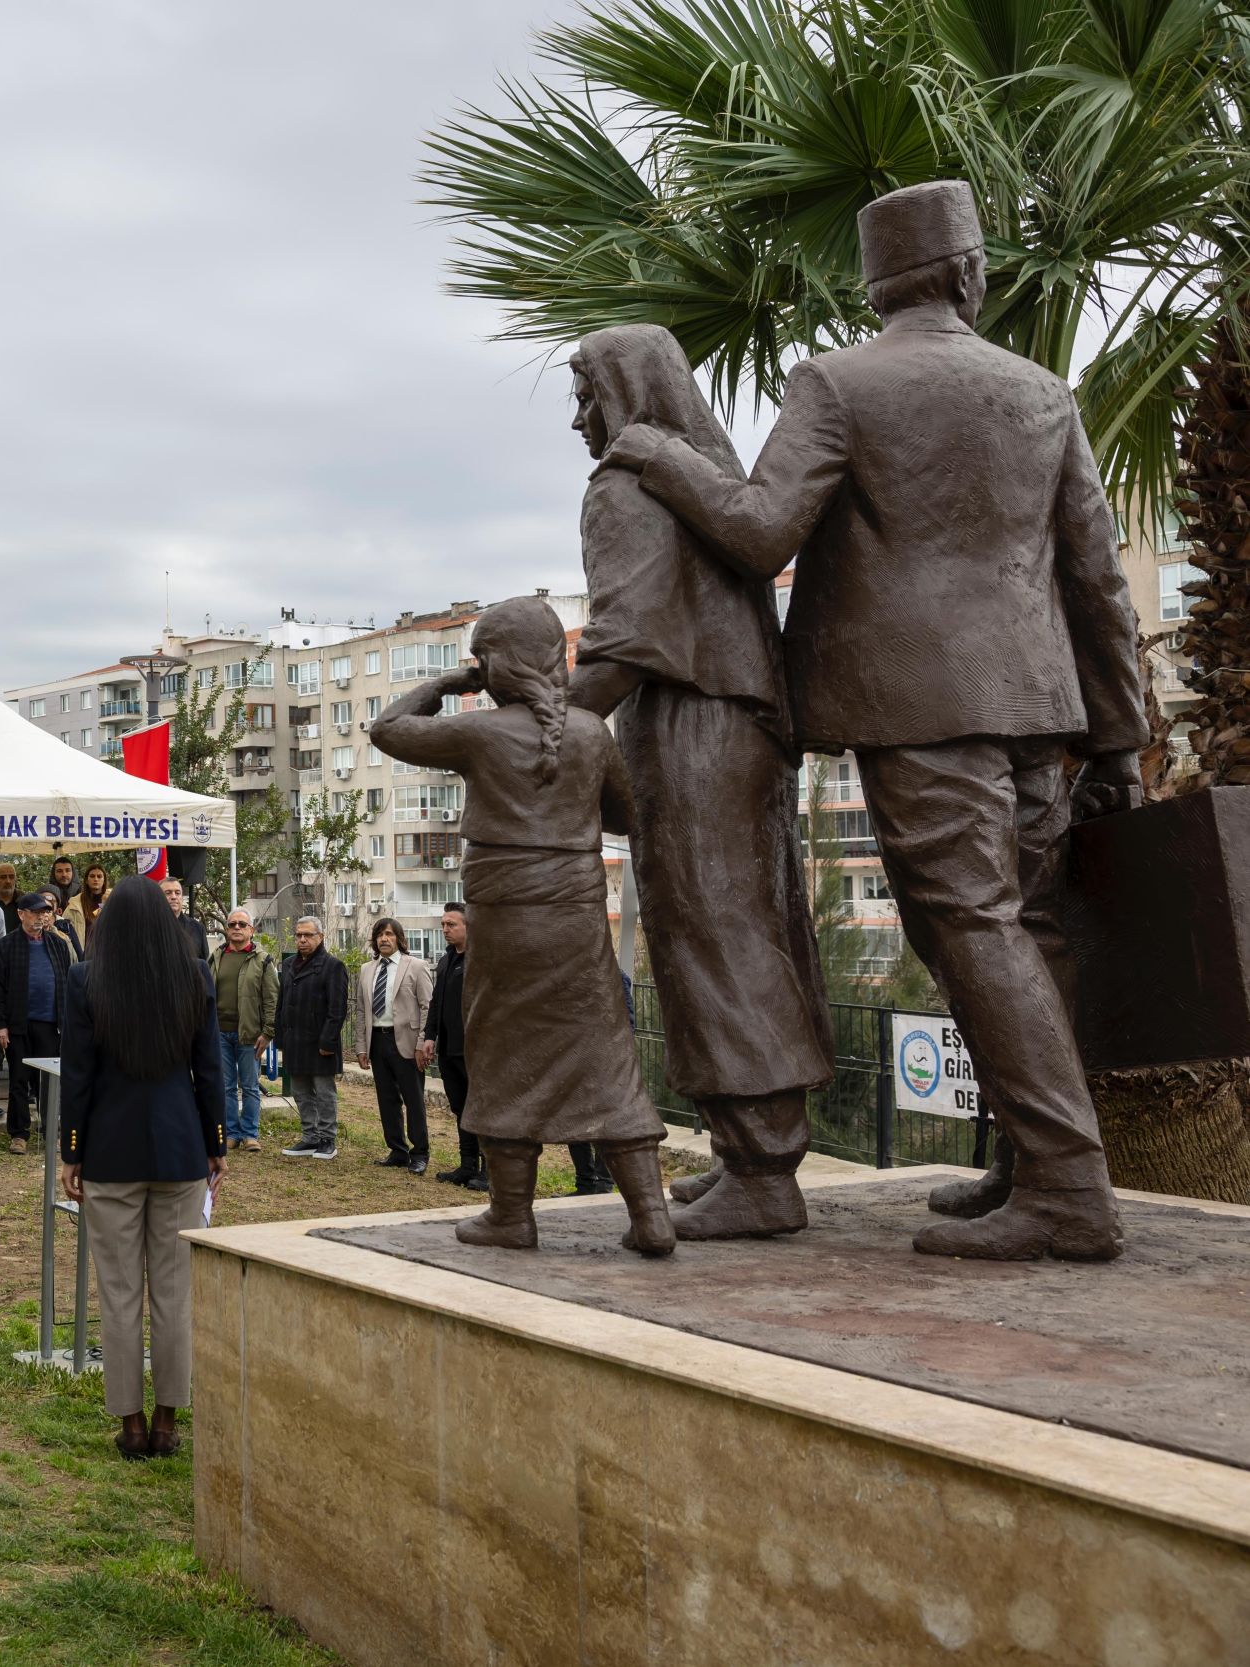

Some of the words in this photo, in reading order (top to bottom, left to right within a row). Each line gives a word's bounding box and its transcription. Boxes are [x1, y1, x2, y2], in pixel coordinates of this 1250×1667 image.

[46, 811, 179, 841] BELEDİYESİ
[942, 1027, 962, 1054] EŞ
[944, 1054, 972, 1080] GİR
